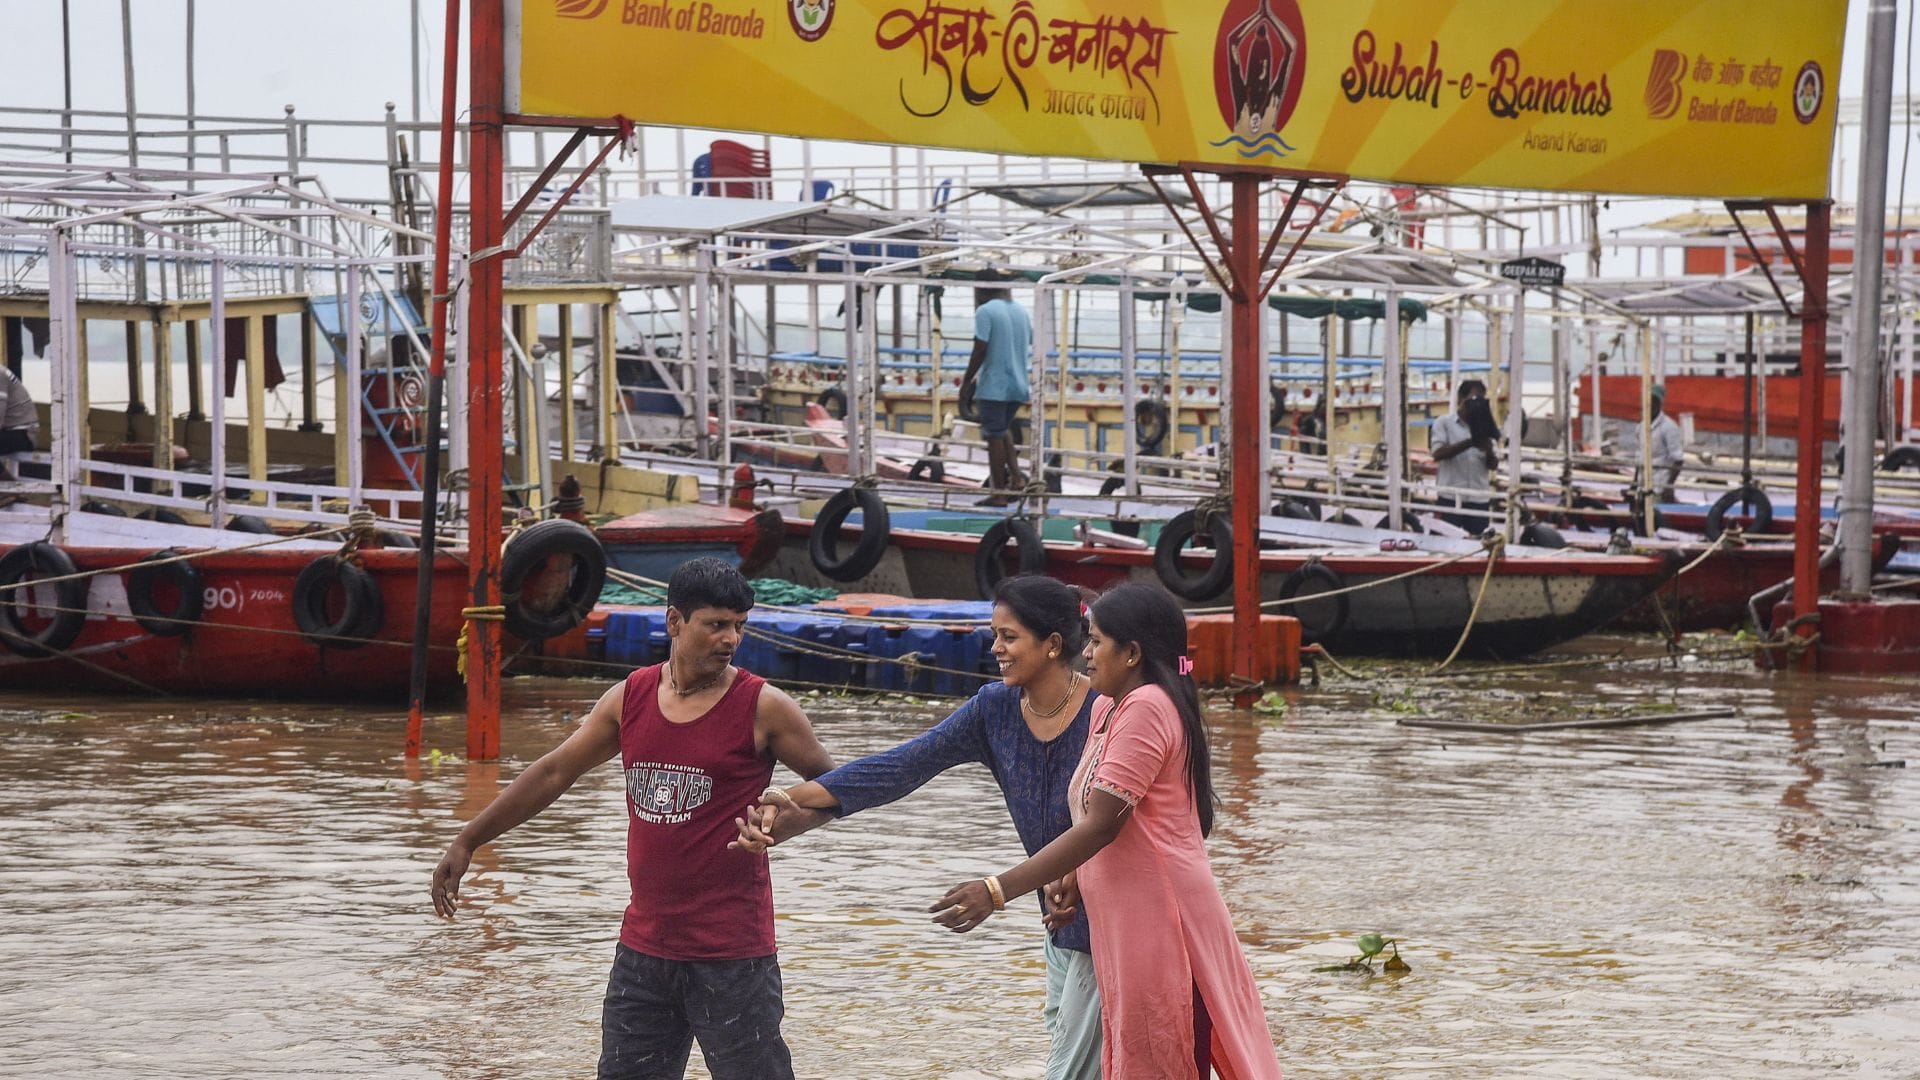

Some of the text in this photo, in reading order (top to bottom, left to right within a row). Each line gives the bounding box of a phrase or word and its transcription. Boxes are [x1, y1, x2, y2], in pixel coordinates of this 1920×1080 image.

[621, 0, 765, 39] Bank of Baroda
[1687, 96, 1778, 125] Bank of Baroda
[1522, 130, 1607, 154] Anand Kanan
[632, 761, 661, 769] ATHLETIC
[626, 768, 713, 813] WHATEVER
[634, 805, 692, 824] VARSITY TEAM
